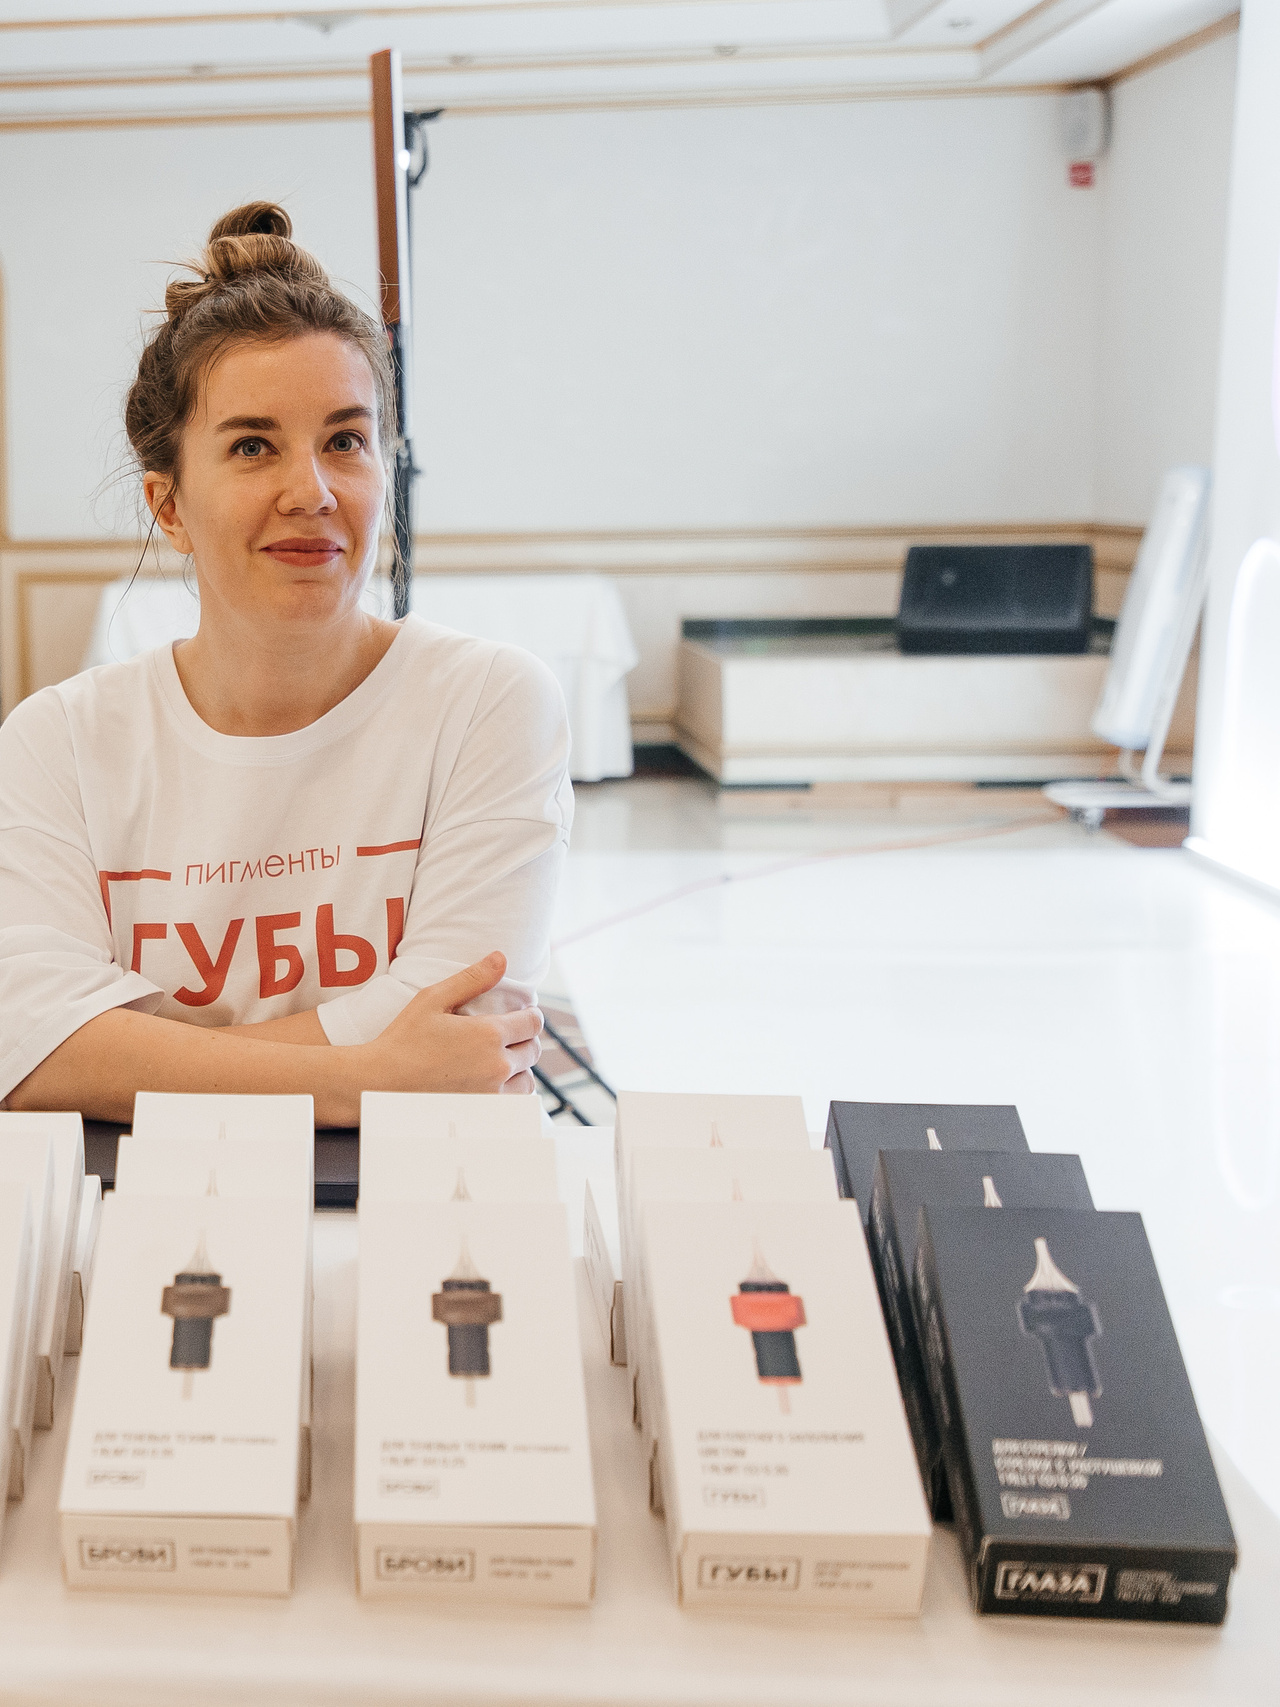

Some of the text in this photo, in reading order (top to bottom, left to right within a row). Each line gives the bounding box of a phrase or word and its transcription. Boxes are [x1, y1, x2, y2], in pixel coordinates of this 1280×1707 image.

[131, 896, 404, 1007] ГУБЫ
[710, 1565, 789, 1583] ГУБЫ
[1007, 1571, 1091, 1594] ГЛАЗА
